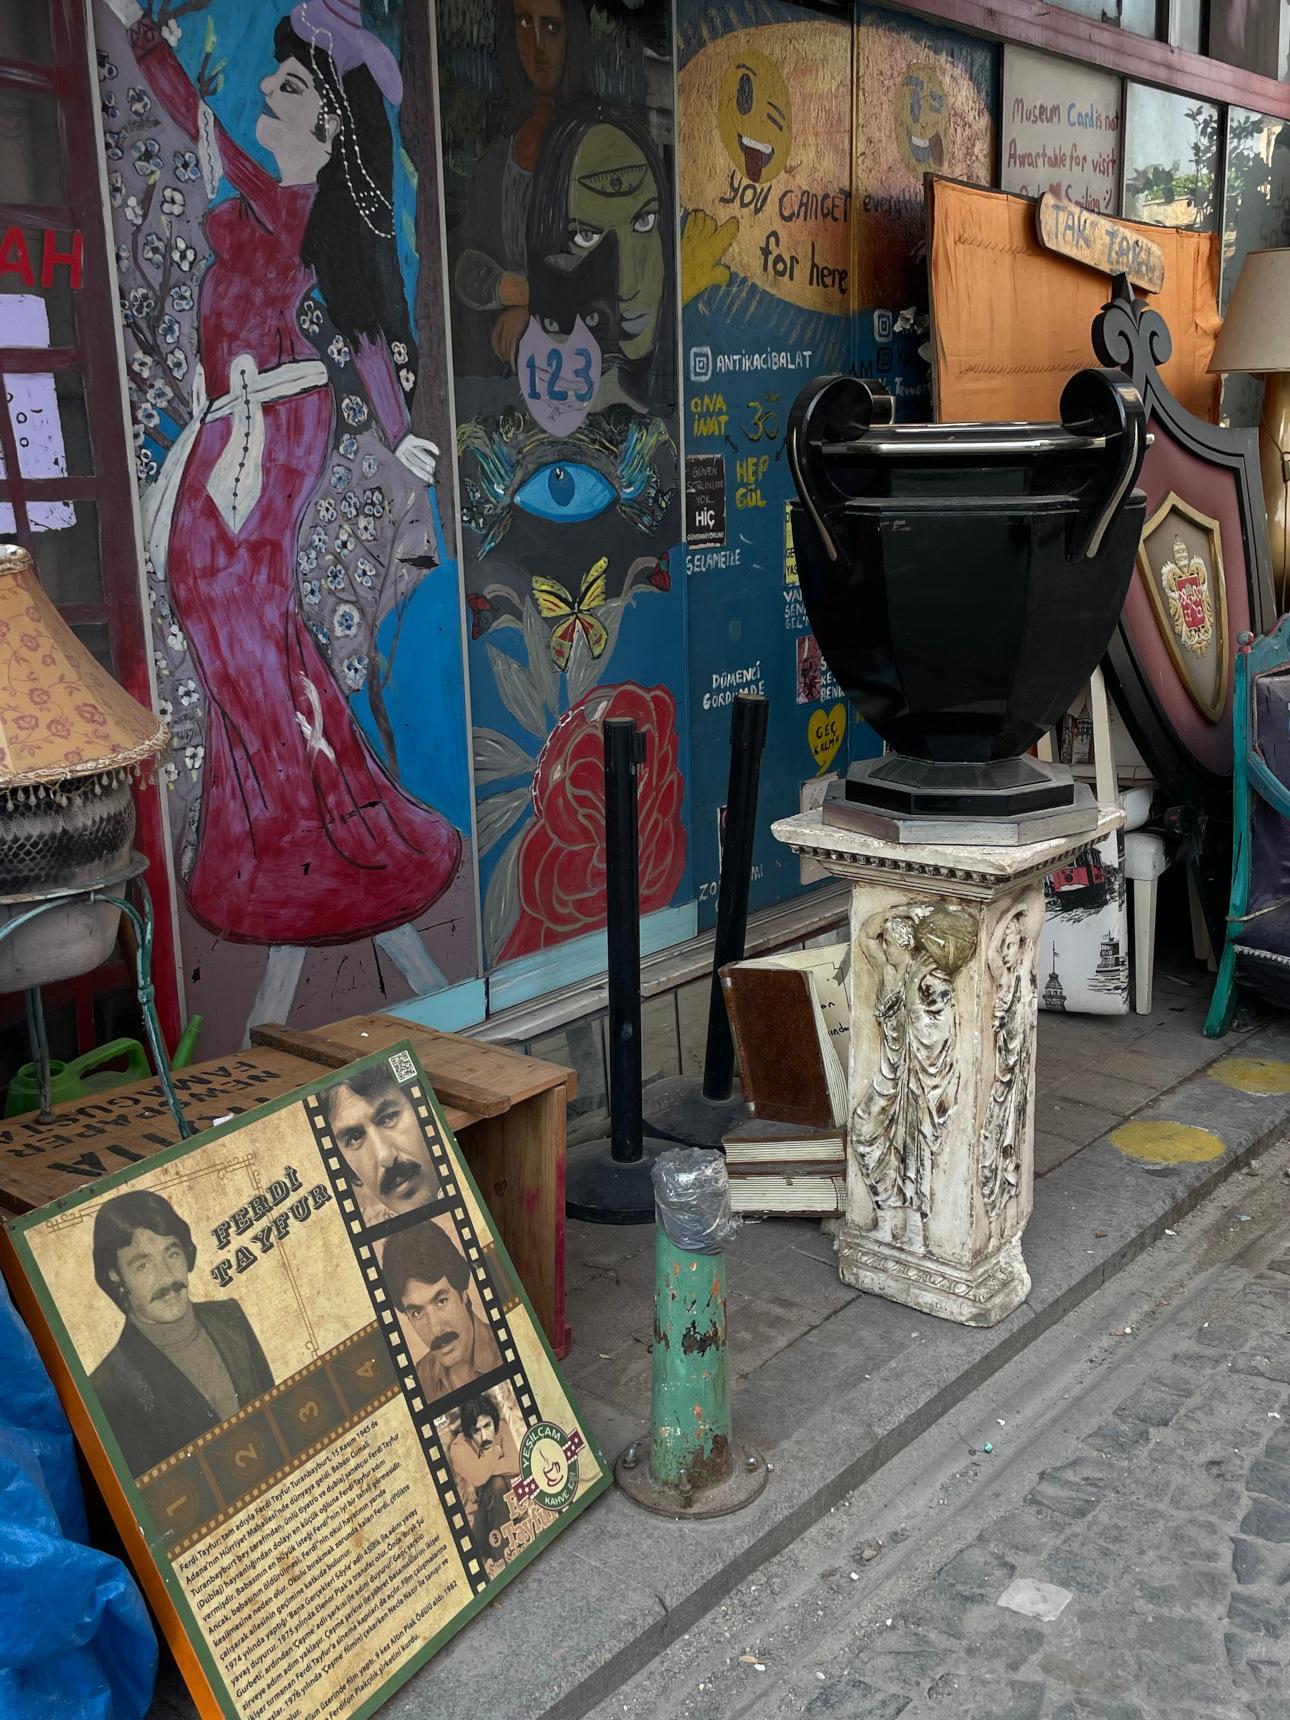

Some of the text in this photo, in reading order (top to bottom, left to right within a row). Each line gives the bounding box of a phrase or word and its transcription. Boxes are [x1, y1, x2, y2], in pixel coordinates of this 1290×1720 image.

[1013, 97, 1060, 124] Museum
[1105, 109, 1119, 131] not
[1070, 142, 1087, 172] for
[1092, 147, 1116, 177] visit
[1051, 203, 1091, 250] TAK
[0, 226, 83, 289] AH
[760, 230, 848, 294] for here
[526, 347, 595, 402] 123
[736, 455, 769, 484] HEP
[695, 507, 715, 529] HİÇ
[816, 720, 837, 739] GEÇ
[211, 1165, 303, 1250] FERDİ
[210, 1183, 333, 1288] TAYFUR
[178, 1553, 198, 1572] Ferdi
[220, 1525, 235, 1541] tam
[254, 1498, 272, 1516] Ferdi
[270, 1483, 292, 1505] Tayfur
[331, 1447, 340, 1458] 15
[338, 1434, 357, 1453] Kasım
[356, 1424, 370, 1440] 1945
[369, 1418, 378, 1429] de
[291, 1524, 300, 1535] en
[352, 1467, 372, 1488] Tayfur
[545, 1492, 570, 1506] KAHVE
[189, 1556, 238, 1599] Turanbayburt
[235, 1546, 250, 1563] bey
[318, 1488, 326, 1499] ve
[367, 1444, 382, 1460] Ferdi
[381, 1431, 400, 1451] Tayfur
[218, 1532, 248, 1560] Hürriyet
[266, 1560, 276, 1570] en
[443, 1579, 457, 1596] 1982
[251, 1593, 273, 1616] neden
[277, 1626, 294, 1645] 1975
[224, 1653, 242, 1672] 1974
[284, 1689, 300, 1707] 1976
